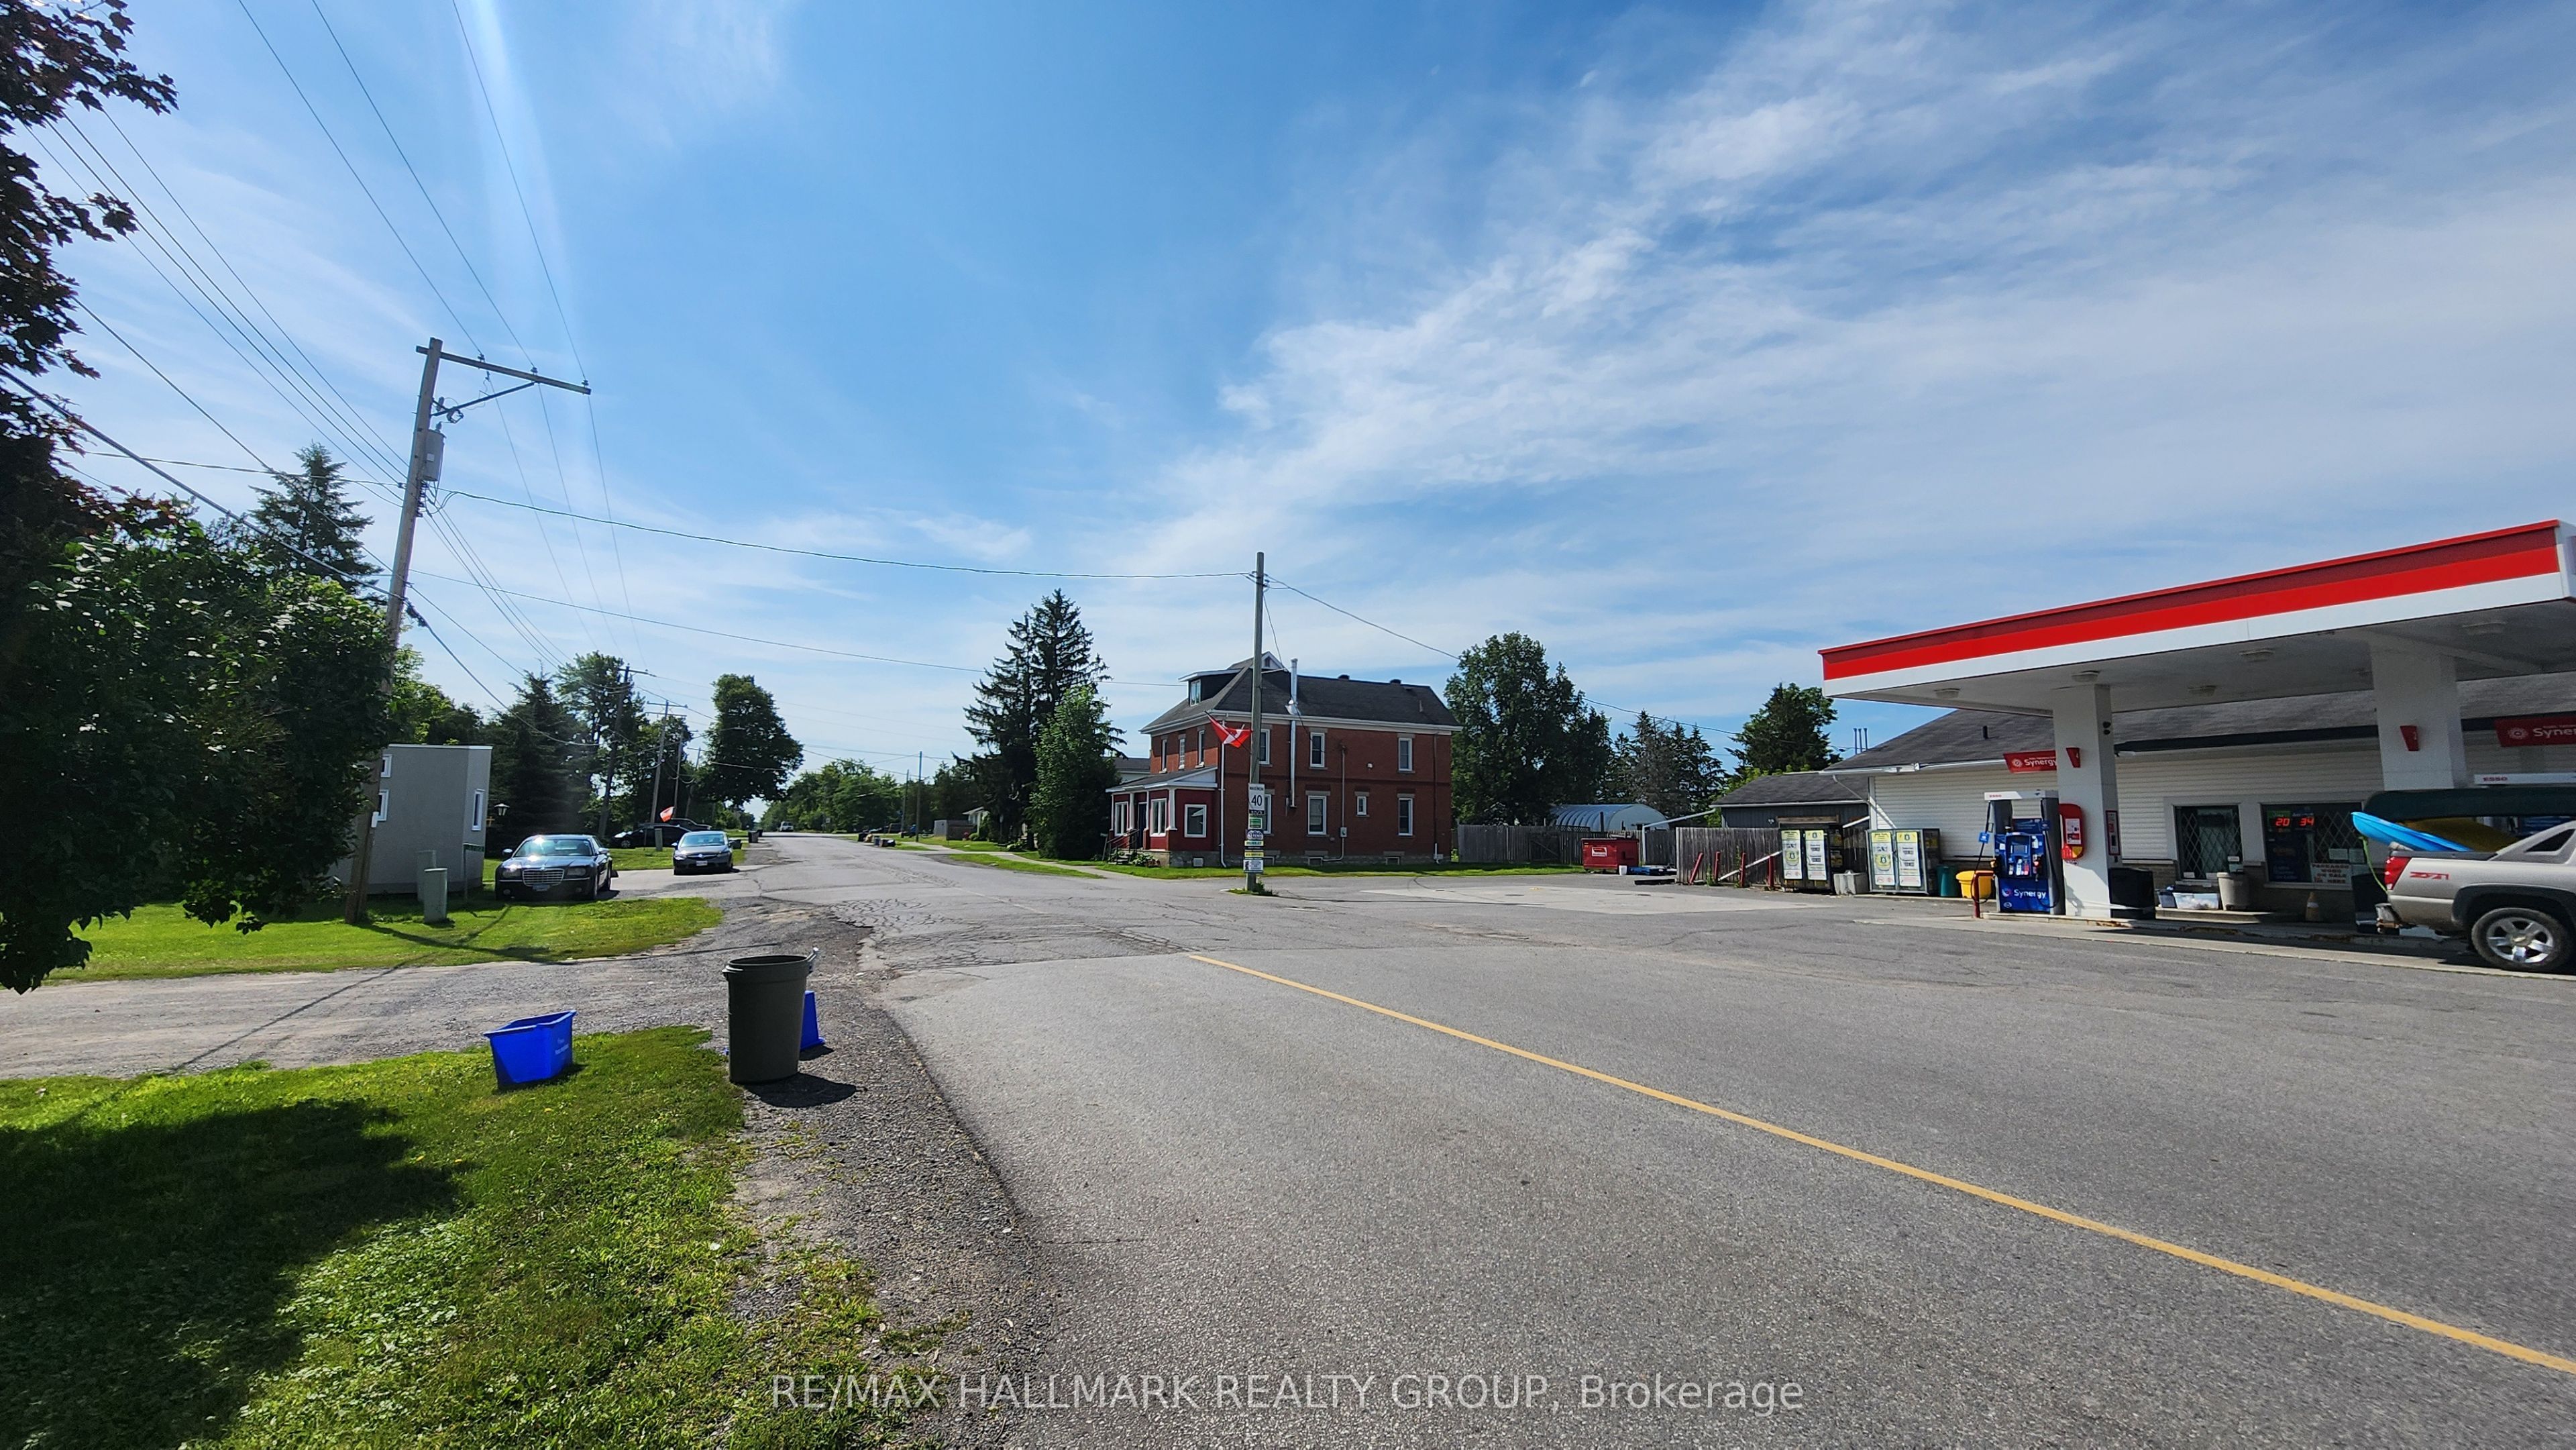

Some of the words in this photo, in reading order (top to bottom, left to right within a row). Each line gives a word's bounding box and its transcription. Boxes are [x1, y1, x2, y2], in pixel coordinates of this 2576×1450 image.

[2024, 758, 2057, 768] Synergy
[1251, 794, 1263, 807] 40
[2275, 817, 2290, 827] 20
[2300, 817, 2314, 827] 34
[2013, 889, 2047, 899] Synergy
